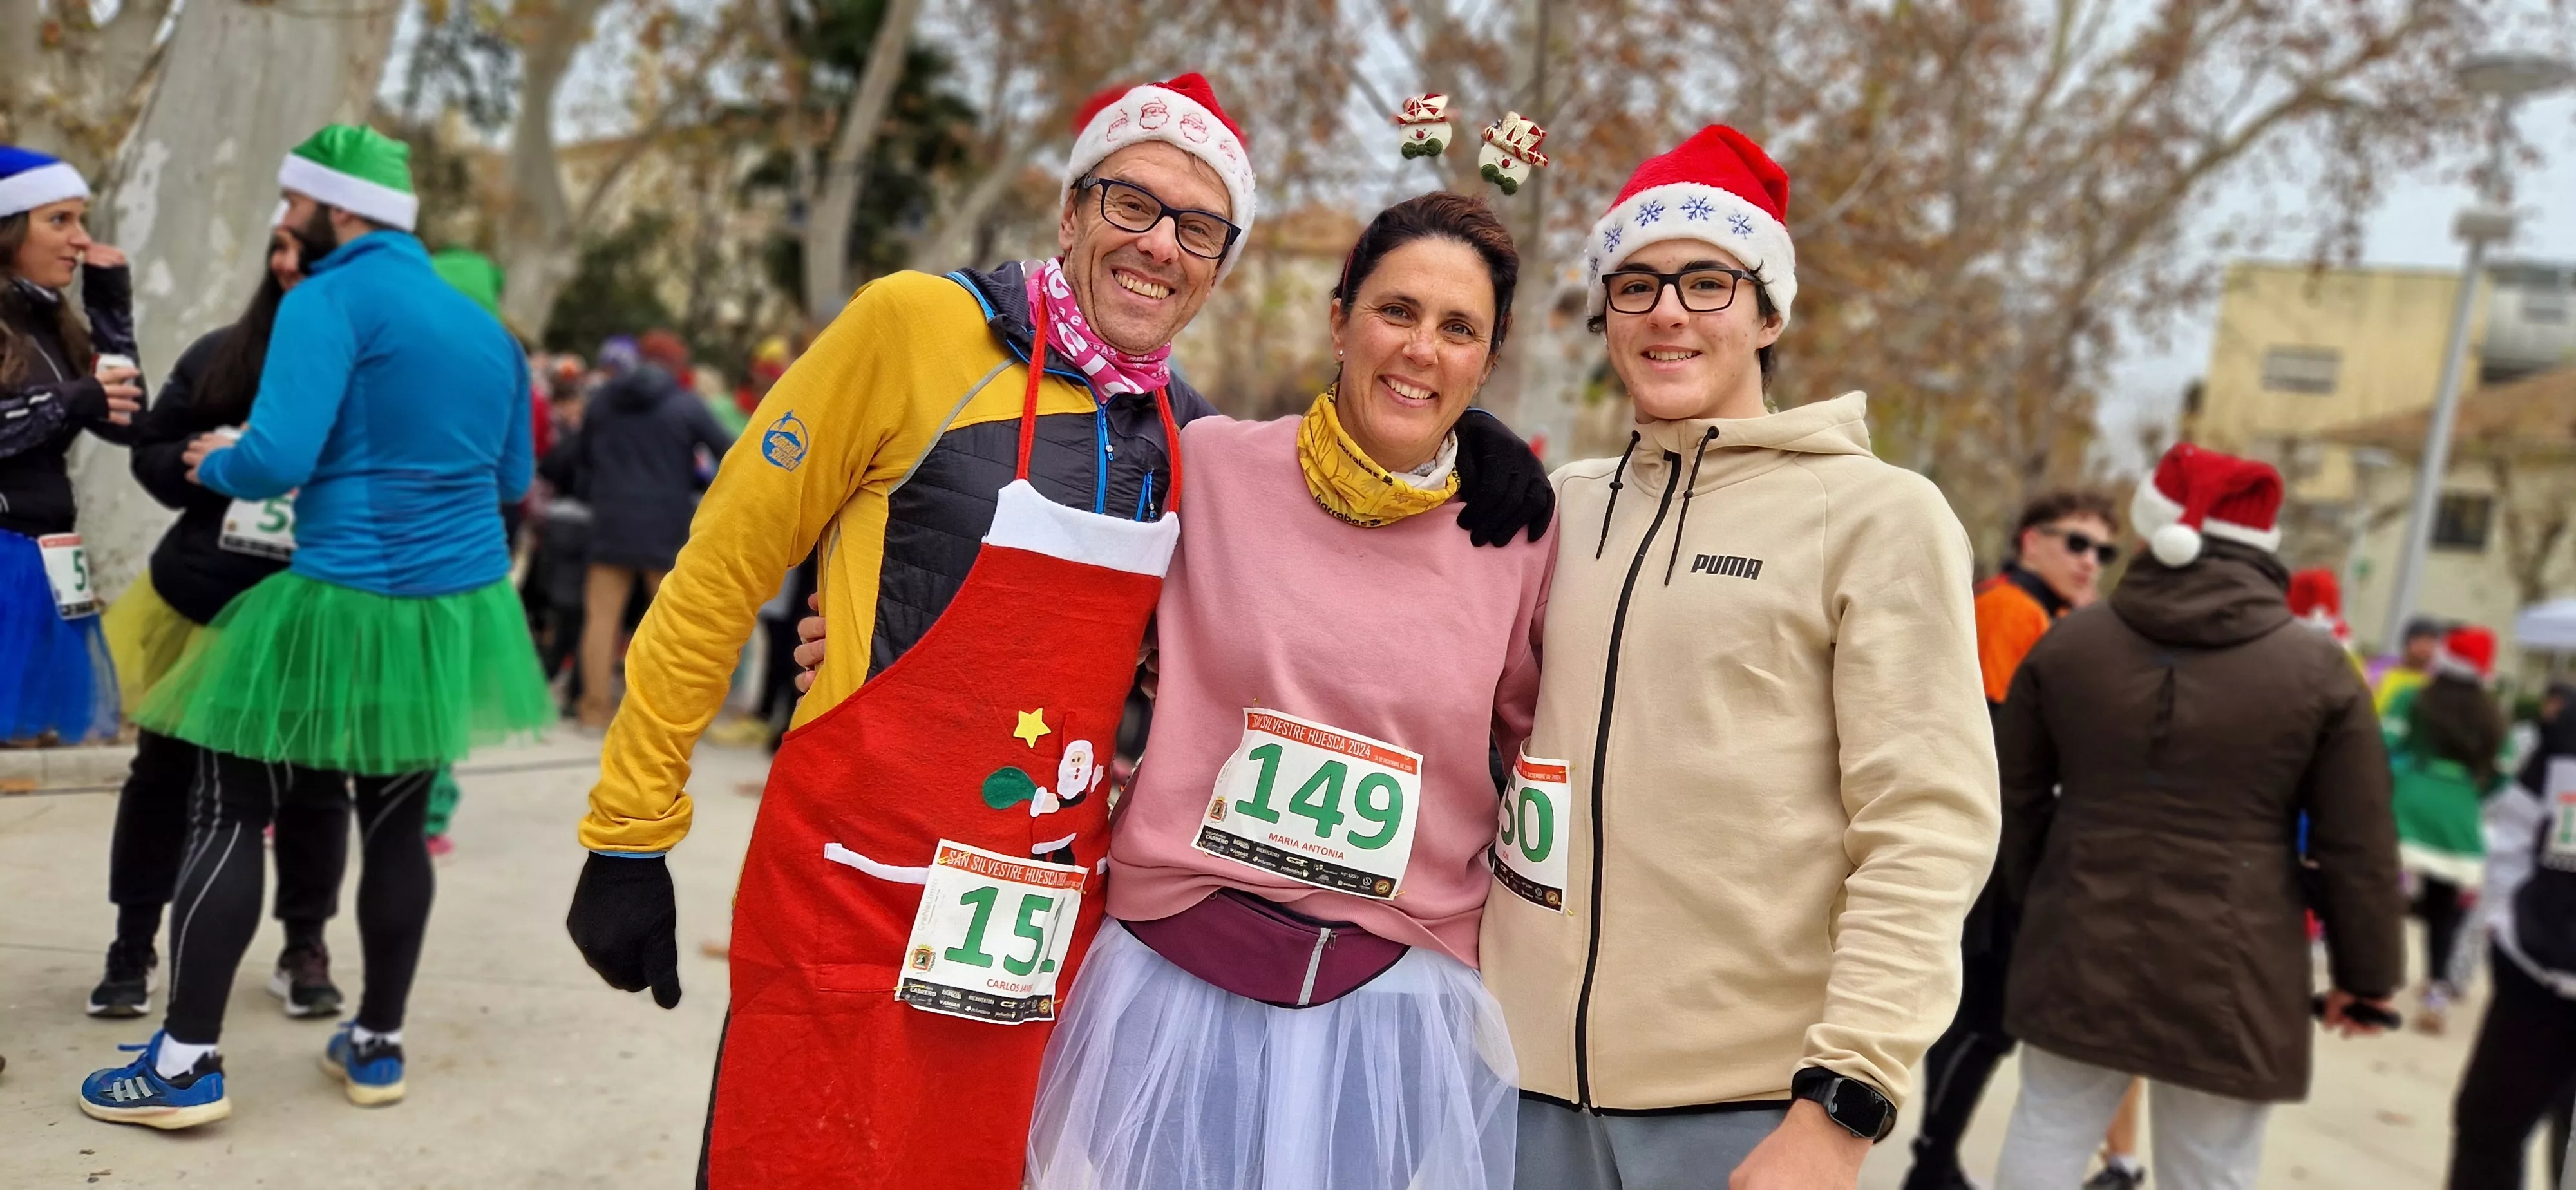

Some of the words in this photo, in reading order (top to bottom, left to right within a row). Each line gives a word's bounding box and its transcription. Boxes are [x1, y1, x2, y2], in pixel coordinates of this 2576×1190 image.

[256, 497, 296, 534] 5
[1690, 554, 1763, 580] PUMA
[1260, 715, 1307, 740] SILVESTRE
[1307, 727, 1345, 751] HUESCA
[1347, 740, 1370, 758] 2024
[1235, 743, 1403, 850] 149
[1269, 832, 1299, 849] MARIA
[1302, 844, 1345, 860] ANTONIA
[948, 850, 971, 867] SAN
[971, 856, 1025, 880] SILVESTRE
[1025, 867, 1058, 885] HUESCA
[910, 987, 937, 997] CABRERO
[987, 979, 1019, 992] CARLOS
